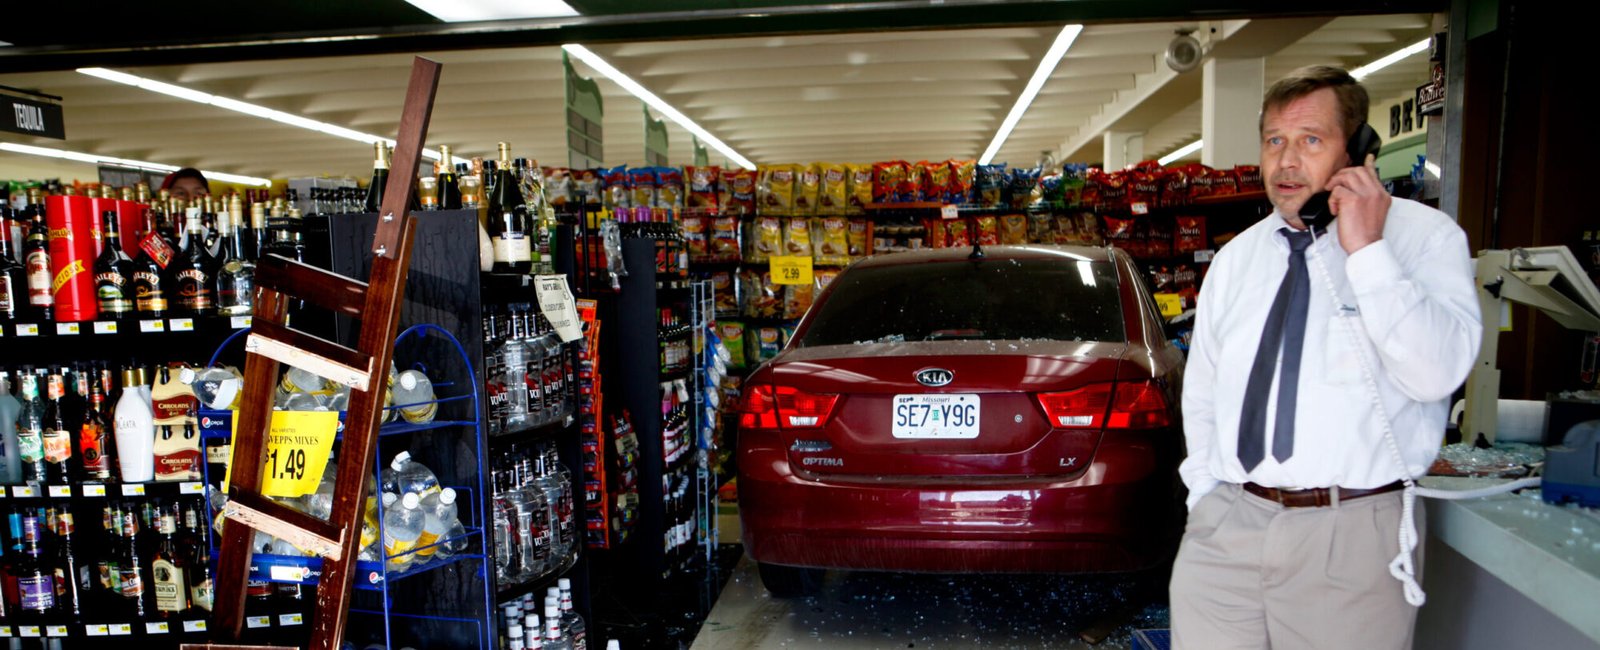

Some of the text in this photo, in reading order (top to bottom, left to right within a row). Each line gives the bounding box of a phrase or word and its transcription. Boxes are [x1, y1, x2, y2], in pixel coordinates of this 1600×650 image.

[1418, 86, 1445, 104] Budwe
[922, 371, 948, 383] KIA
[897, 404, 975, 427] SE7 Y9G
[295, 435, 319, 446] MIXES
[802, 457, 844, 467] OPTIMA
[1059, 457, 1077, 466] LX
